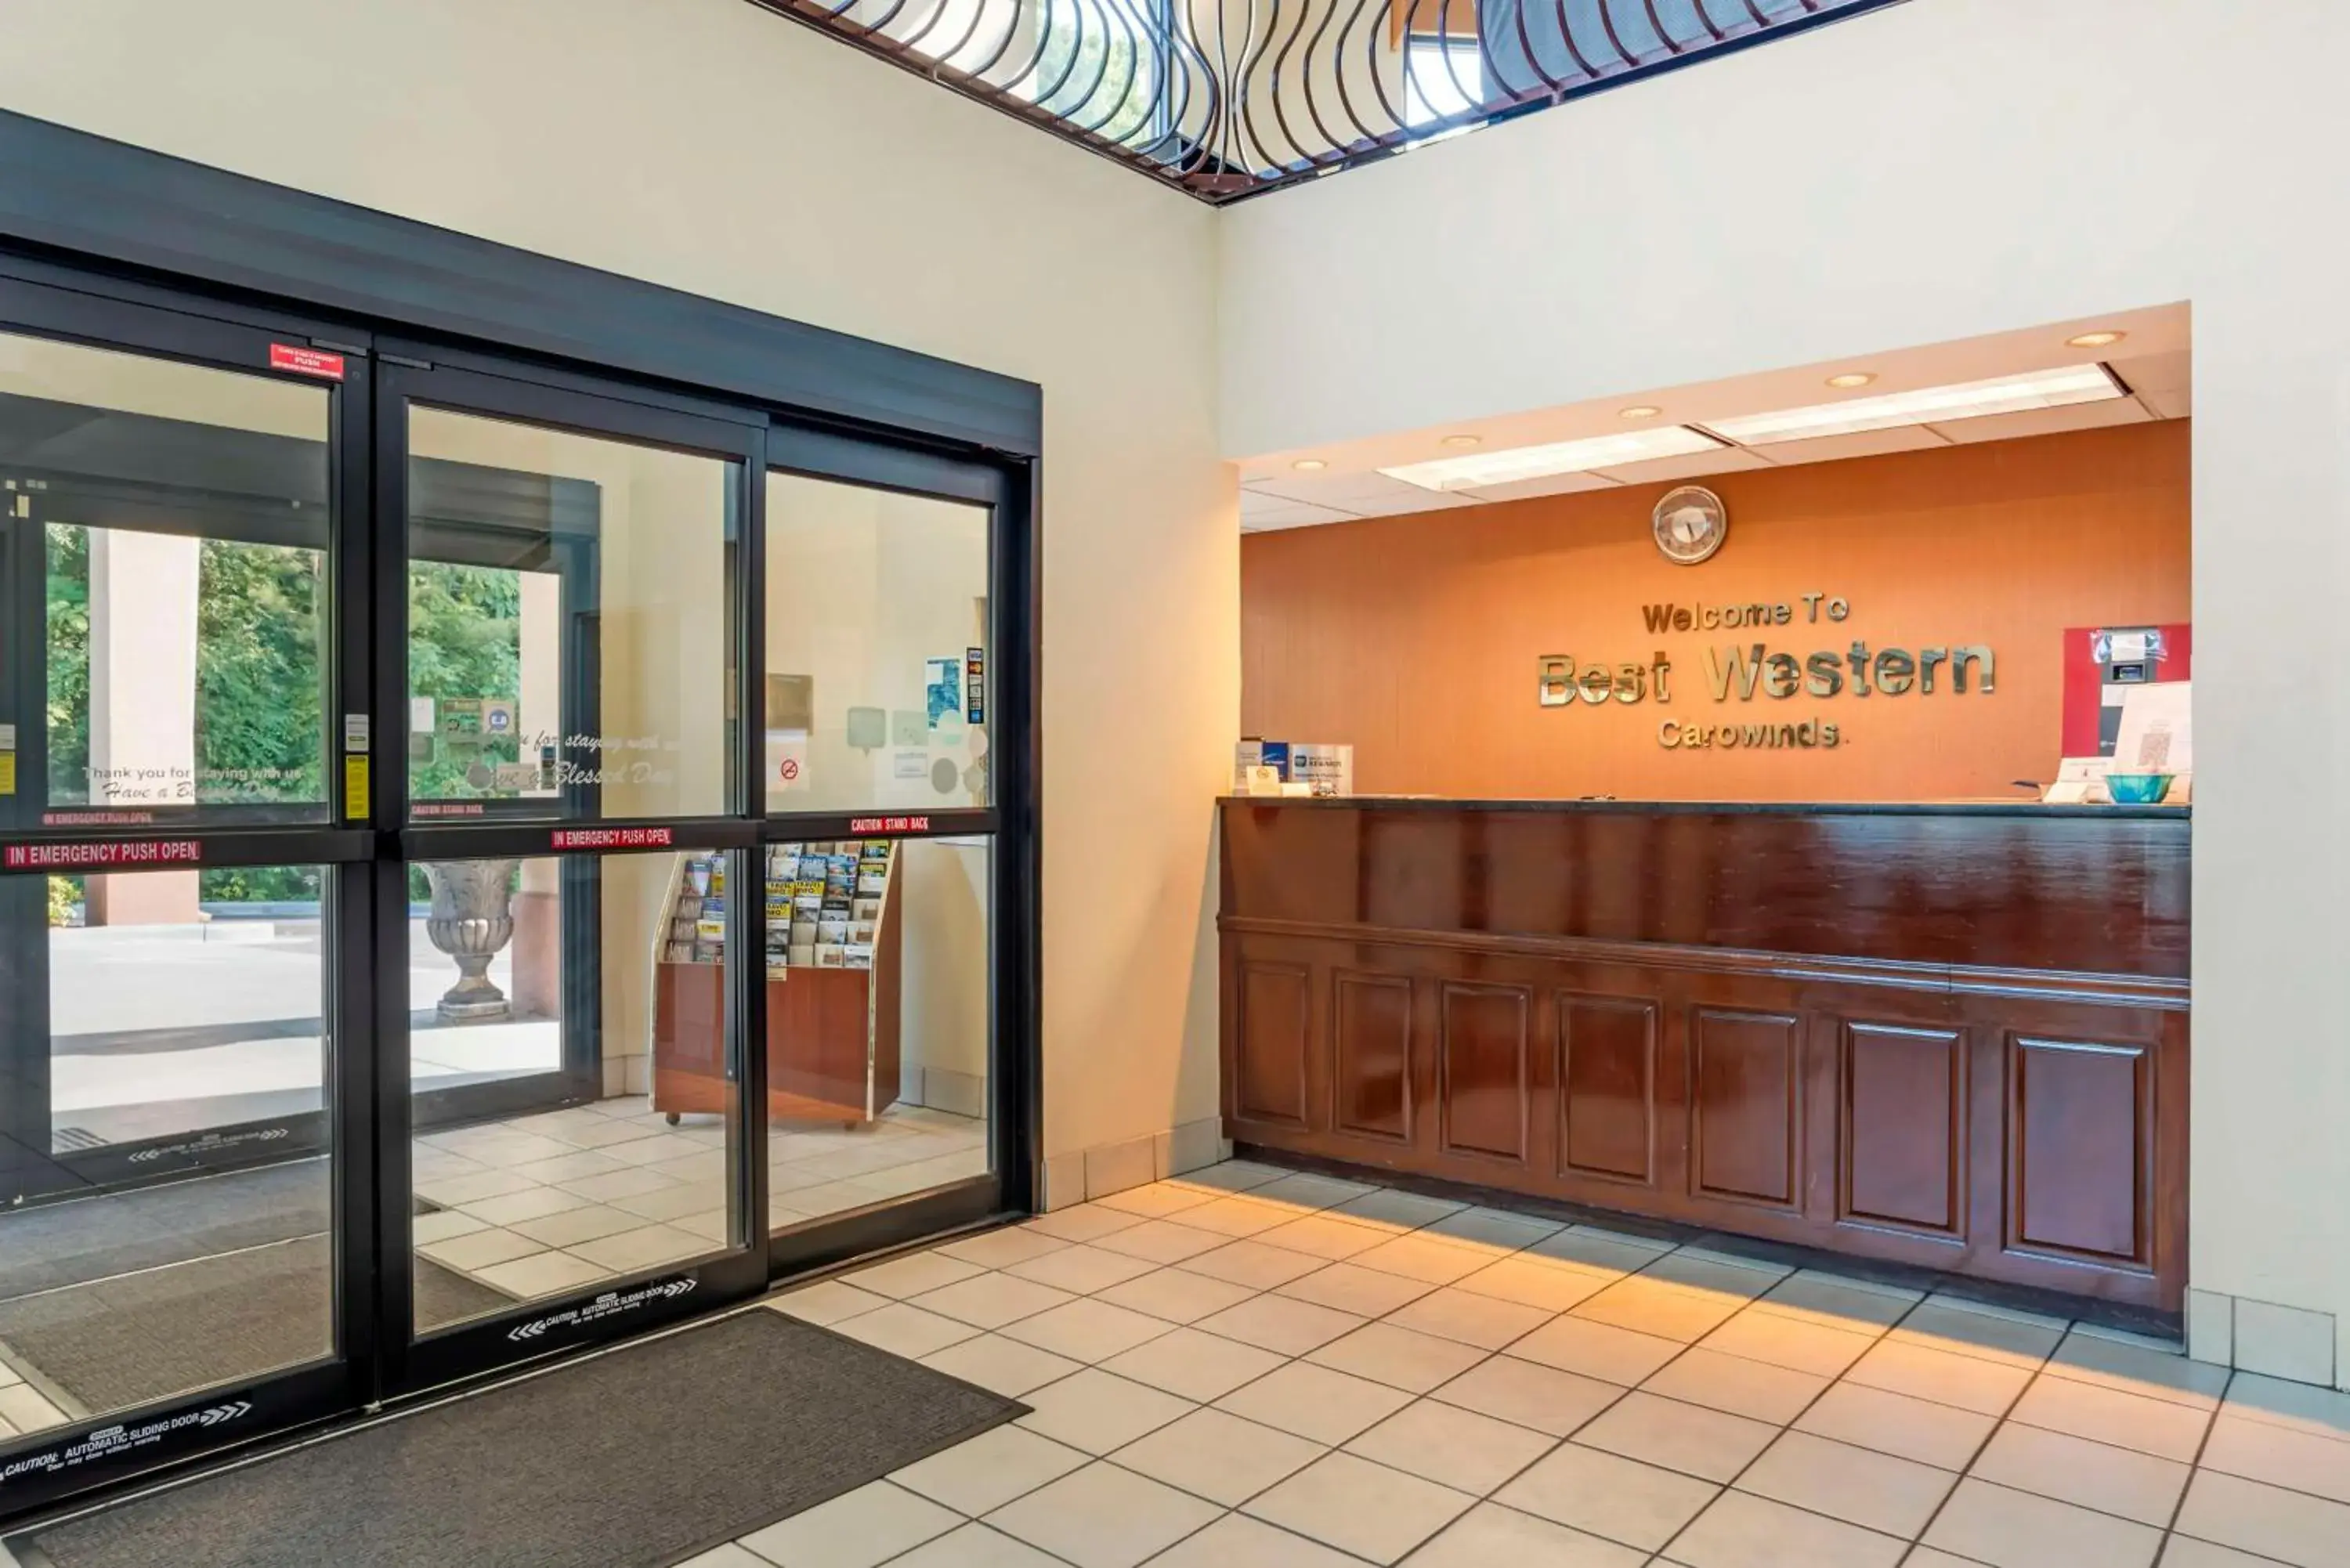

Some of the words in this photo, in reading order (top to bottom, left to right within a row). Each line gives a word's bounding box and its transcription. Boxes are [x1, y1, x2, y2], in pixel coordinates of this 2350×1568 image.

[1643, 602, 1792, 634] Welcome
[1802, 591, 1850, 623] To
[1538, 650, 1671, 706] Best
[1701, 639, 1995, 702] Western
[1656, 717, 1840, 749] Carowinds
[82, 766, 130, 779] Thank
[137, 769, 166, 782] you
[170, 765, 190, 779] for
[101, 781, 153, 799] Have
[554, 831, 564, 846] IN
[566, 829, 620, 845] EMERGENCY
[622, 828, 645, 844] PUSH
[647, 828, 671, 844] OPEN
[9, 846, 27, 865] IN
[31, 844, 118, 864] EMERGENCY
[121, 842, 157, 861] PUSH
[161, 841, 198, 860] OPEN
[64, 1432, 128, 1459] AUTOMATIC
[129, 1419, 169, 1440] SLIDING
[172, 1412, 200, 1429] DOOR
[46, 1460, 65, 1472] Door
[67, 1458, 83, 1469] may
